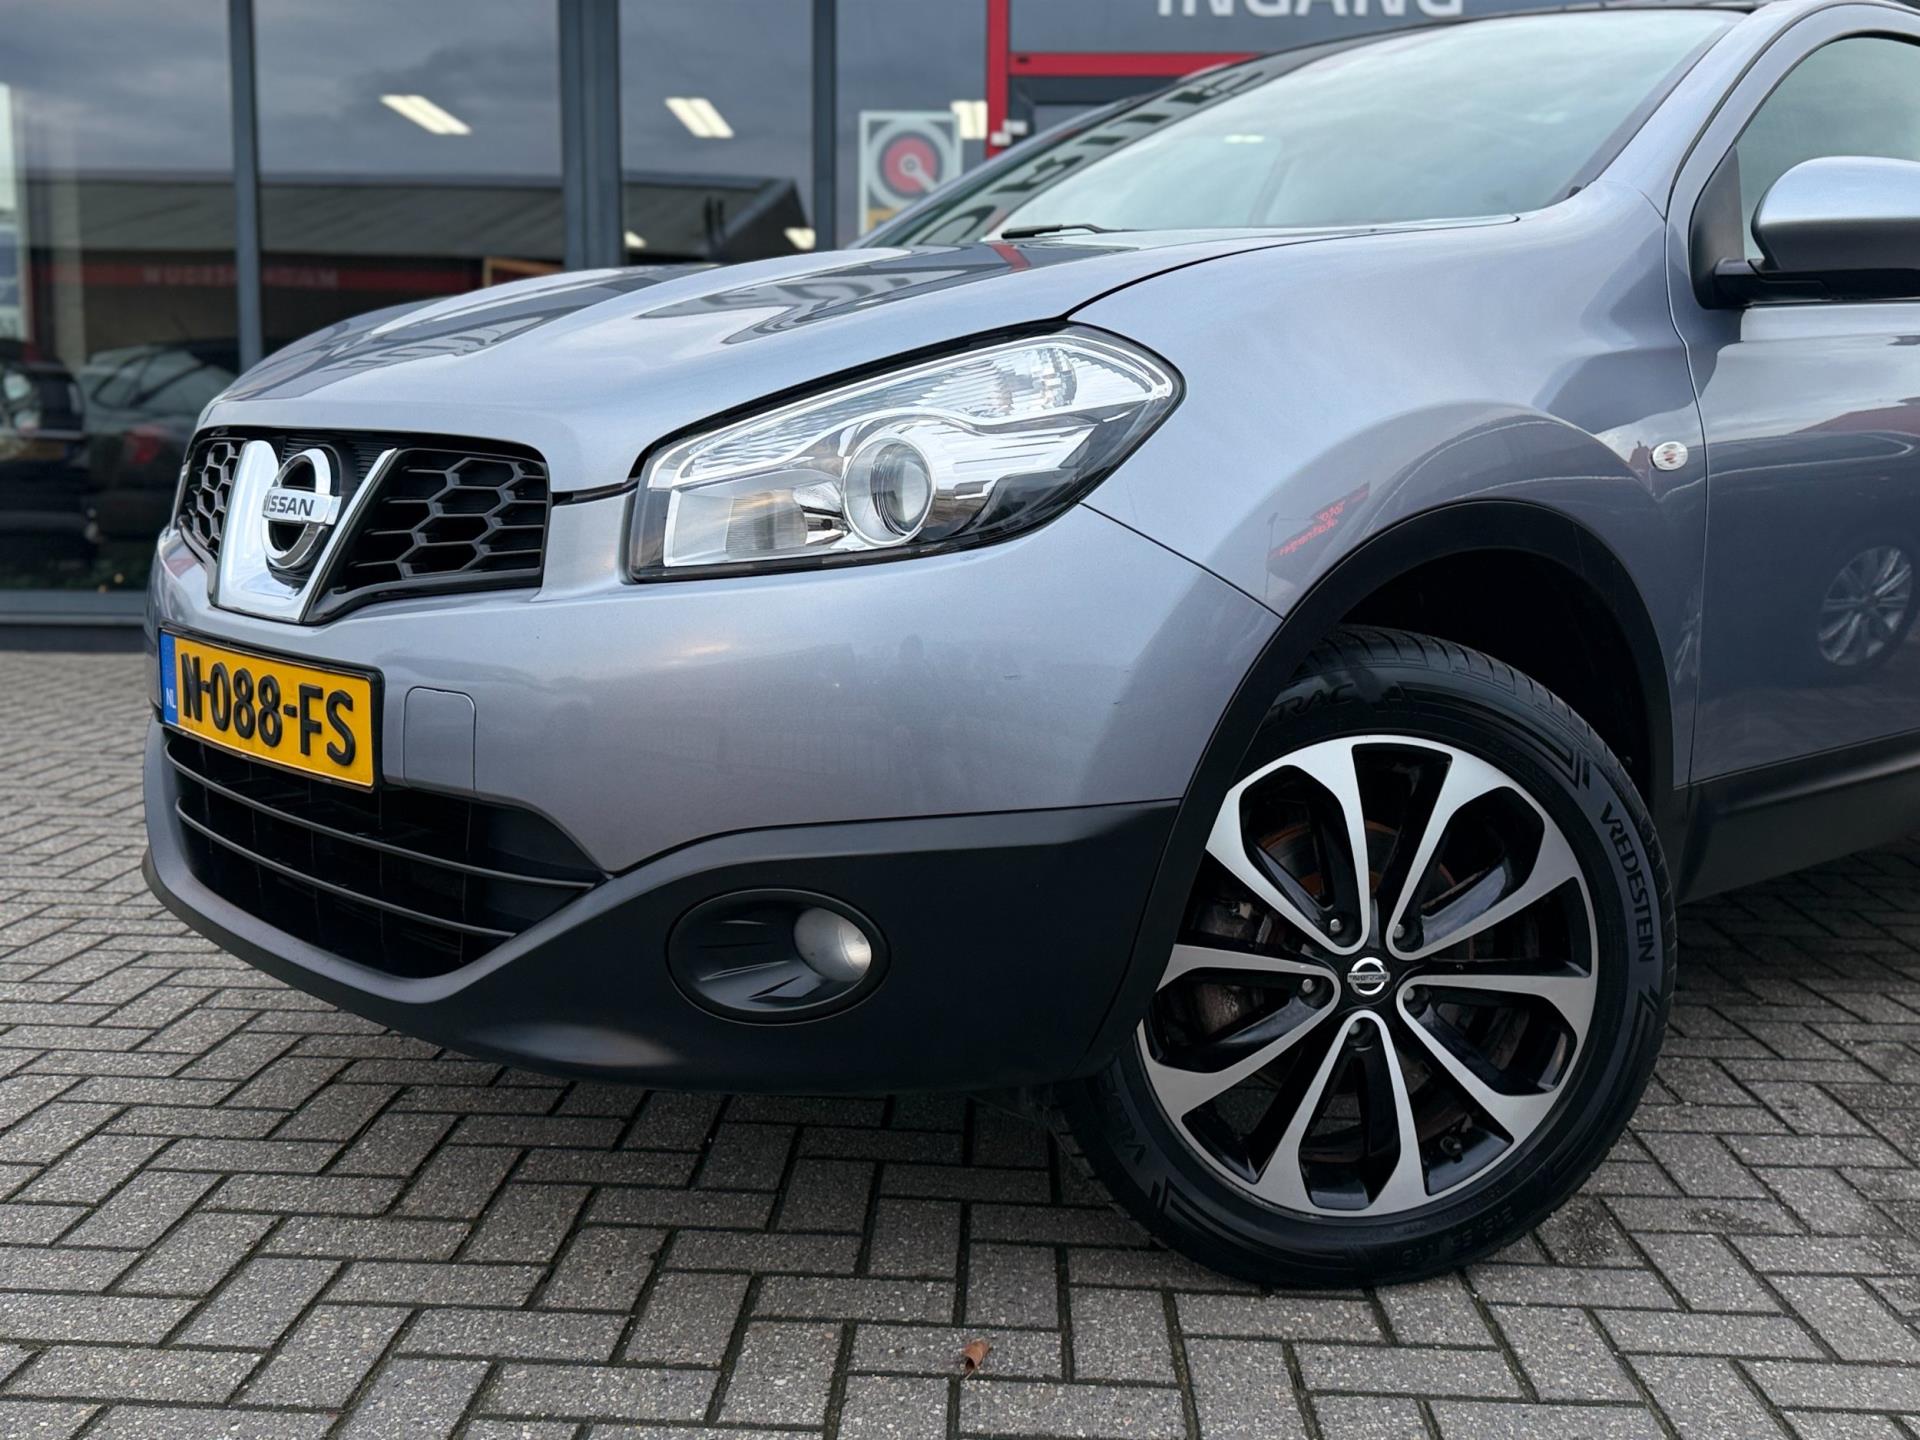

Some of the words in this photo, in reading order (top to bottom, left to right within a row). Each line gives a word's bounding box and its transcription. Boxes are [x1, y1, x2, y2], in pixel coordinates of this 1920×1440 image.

[166, 687, 177, 709] NL
[181, 652, 356, 766] N-088-FS
[1600, 801, 1655, 963] VREDESTEIN
